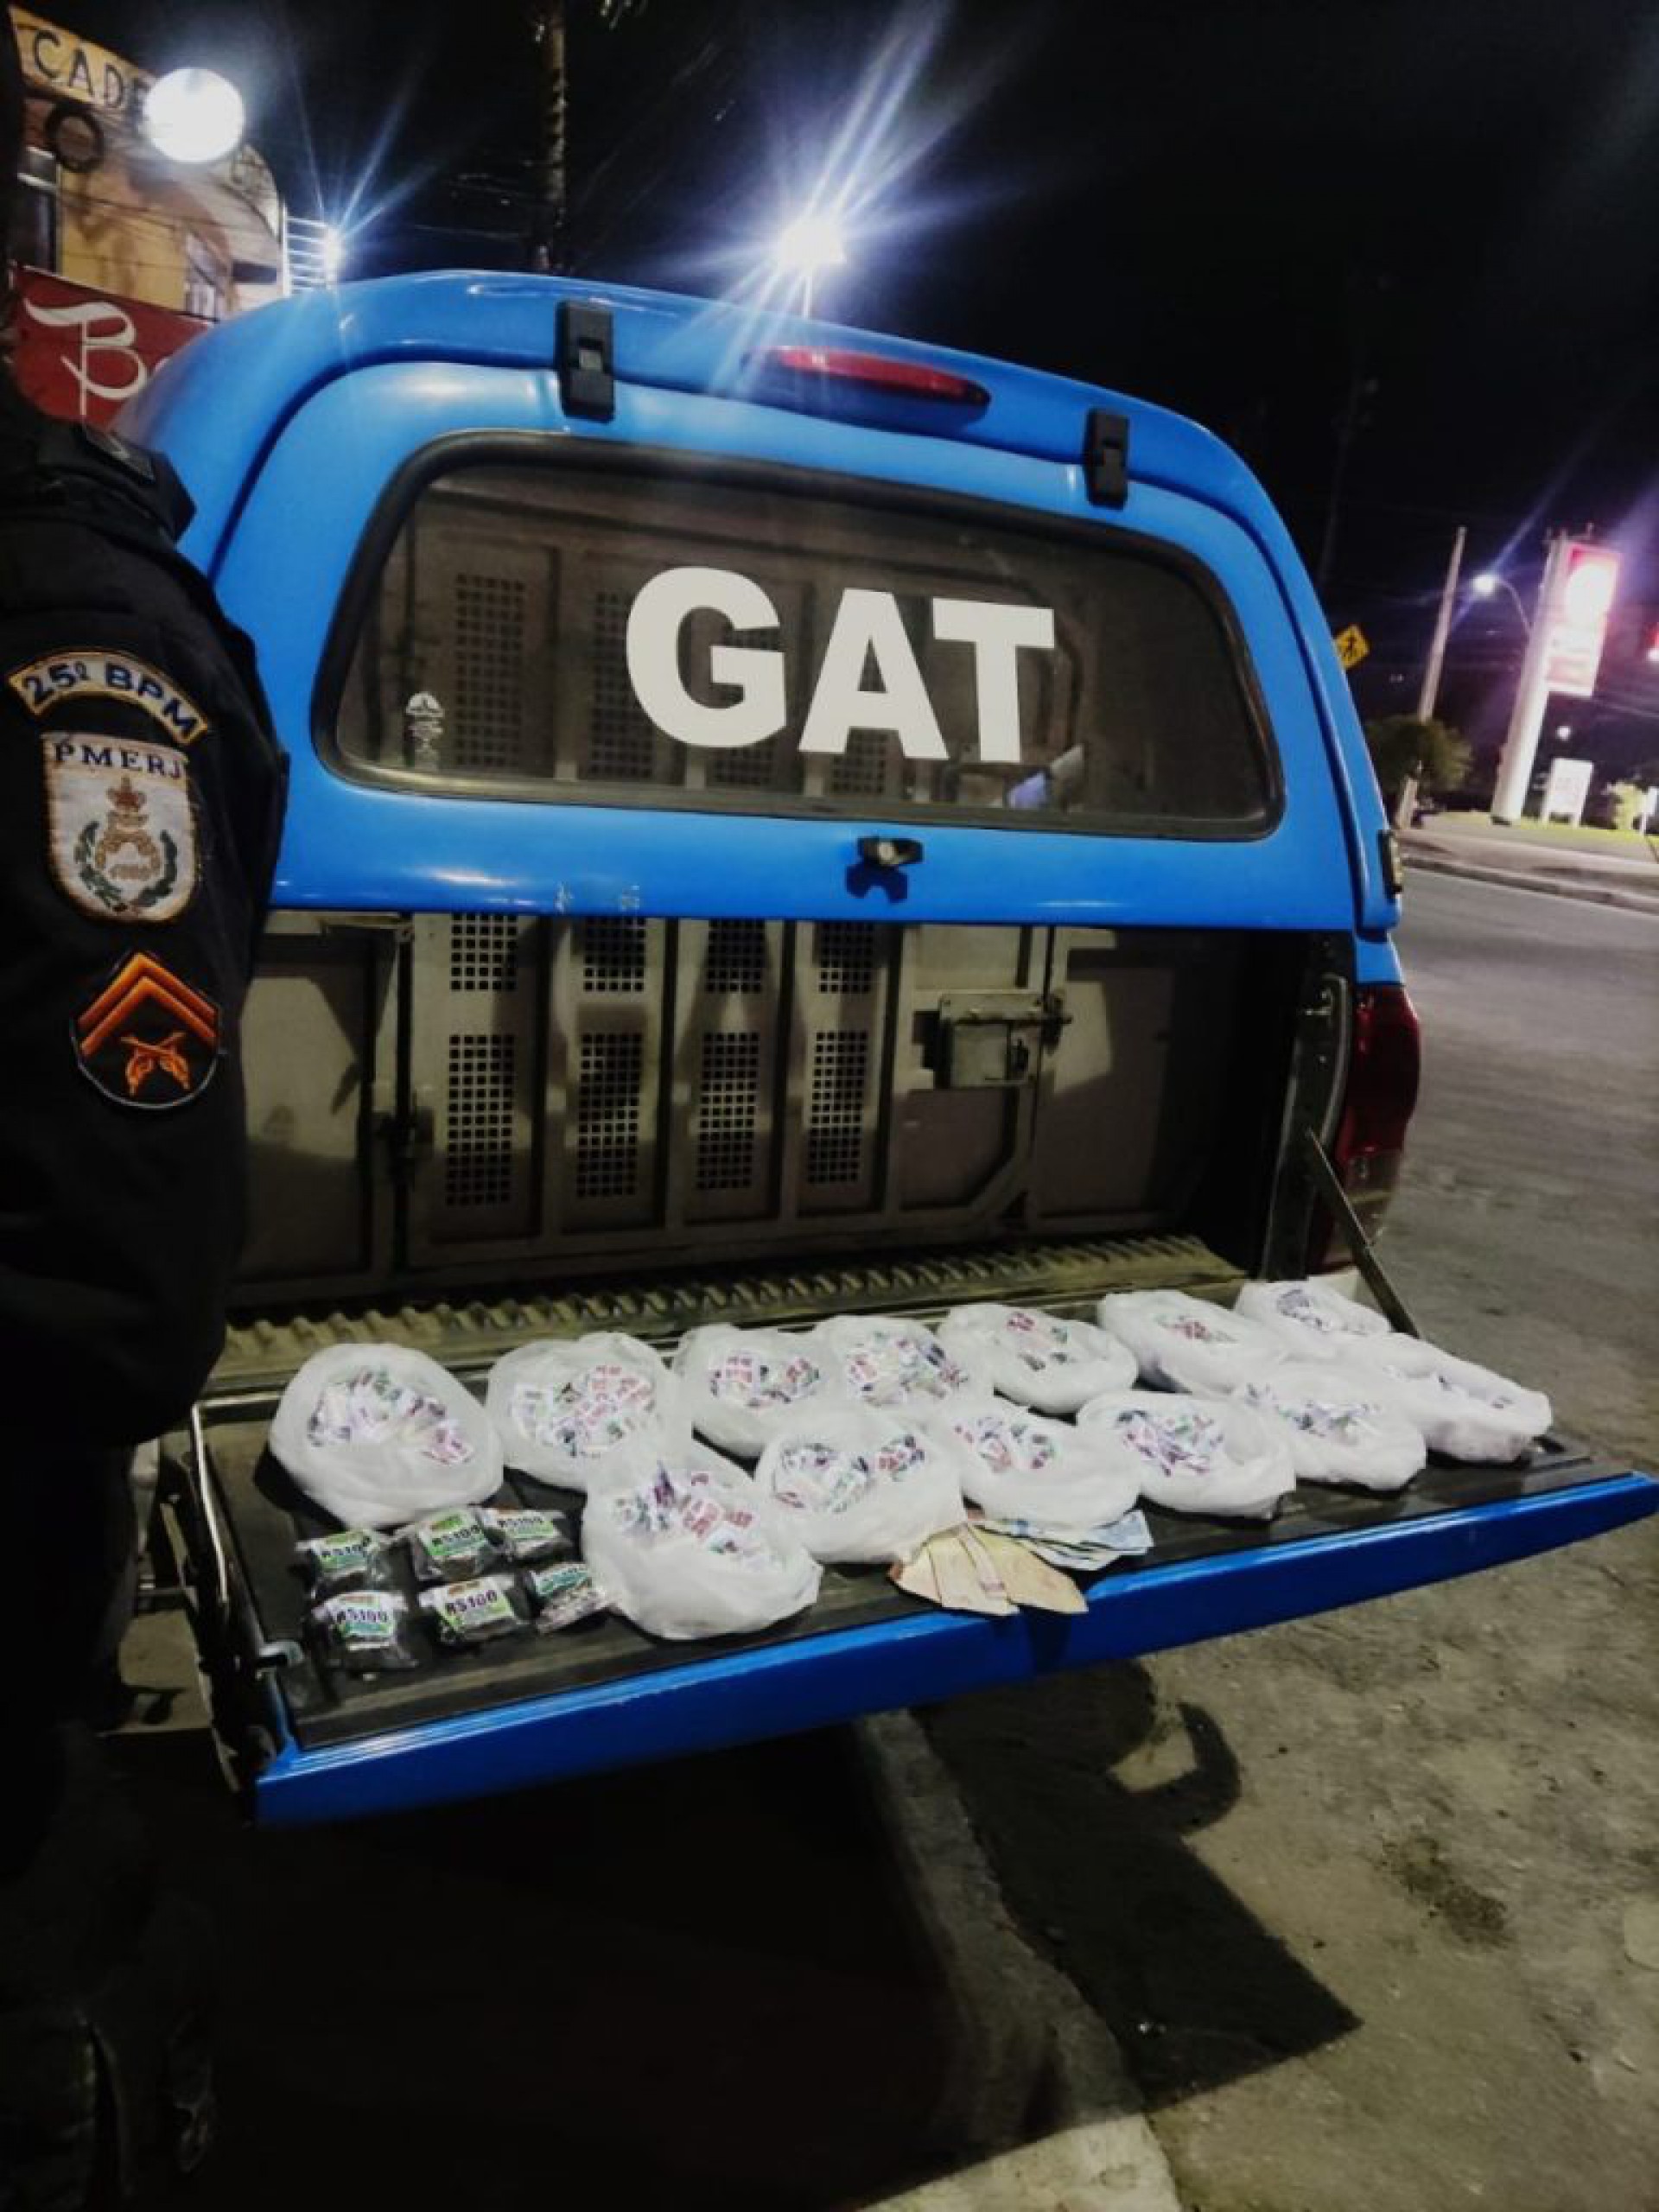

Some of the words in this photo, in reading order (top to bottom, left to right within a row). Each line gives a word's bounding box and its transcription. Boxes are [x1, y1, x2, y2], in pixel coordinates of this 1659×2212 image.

[105, 660, 198, 737] BPM
[626, 566, 1056, 764] GAT
[53, 741, 182, 779] PMERJ
